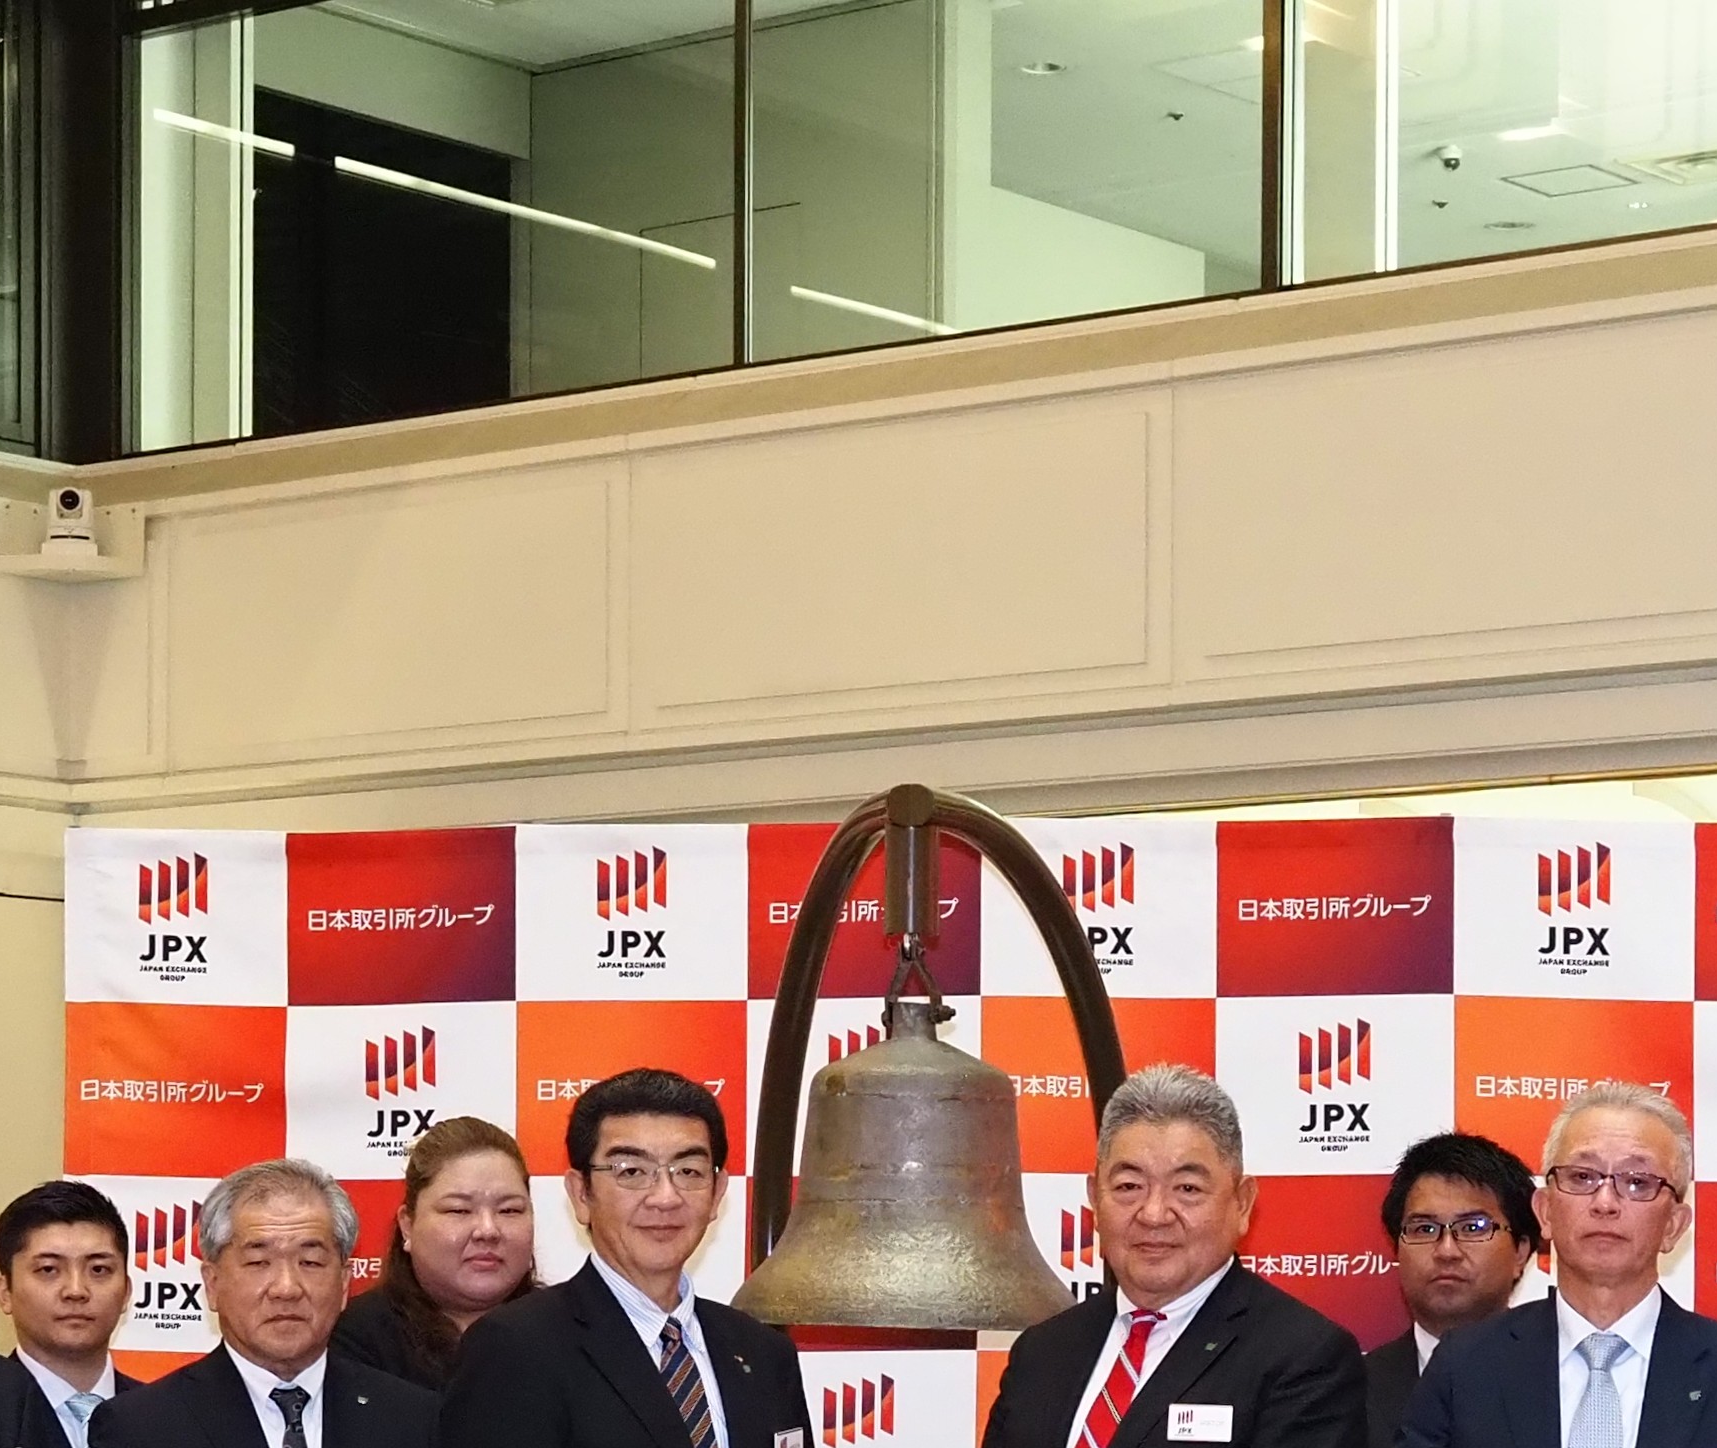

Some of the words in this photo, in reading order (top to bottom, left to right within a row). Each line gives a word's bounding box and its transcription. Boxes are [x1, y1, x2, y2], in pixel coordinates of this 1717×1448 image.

[308, 903, 495, 931] 日本取引所グループ
[1238, 893, 1432, 921] 日本取引所グループ
[139, 934, 207, 964] JPX
[597, 930, 666, 958] JPX
[1087, 926, 1134, 954] PX
[1538, 926, 1610, 956] JPX
[139, 965, 164, 973] JAPAN
[166, 965, 208, 974] EXCHANGE
[597, 962, 622, 970] JAPAN
[625, 961, 667, 969] EXCHANGE
[1096, 958, 1134, 966] XCHANGE
[1539, 958, 1565, 966] JAPAN
[1567, 959, 1610, 967] EXCHANGE
[80, 1079, 264, 1103] 日本取引所グループ
[367, 1110, 435, 1137] JPX
[1299, 1103, 1370, 1132] JPX
[1299, 1135, 1325, 1143] JAPAN
[1327, 1135, 1370, 1143] EXCHANGE
[1240, 1252, 1399, 1277] 日本取引所グル
[135, 1282, 201, 1310] JPX
[134, 1312, 159, 1320] JAPAN
[161, 1313, 202, 1322] EXCHANGE
